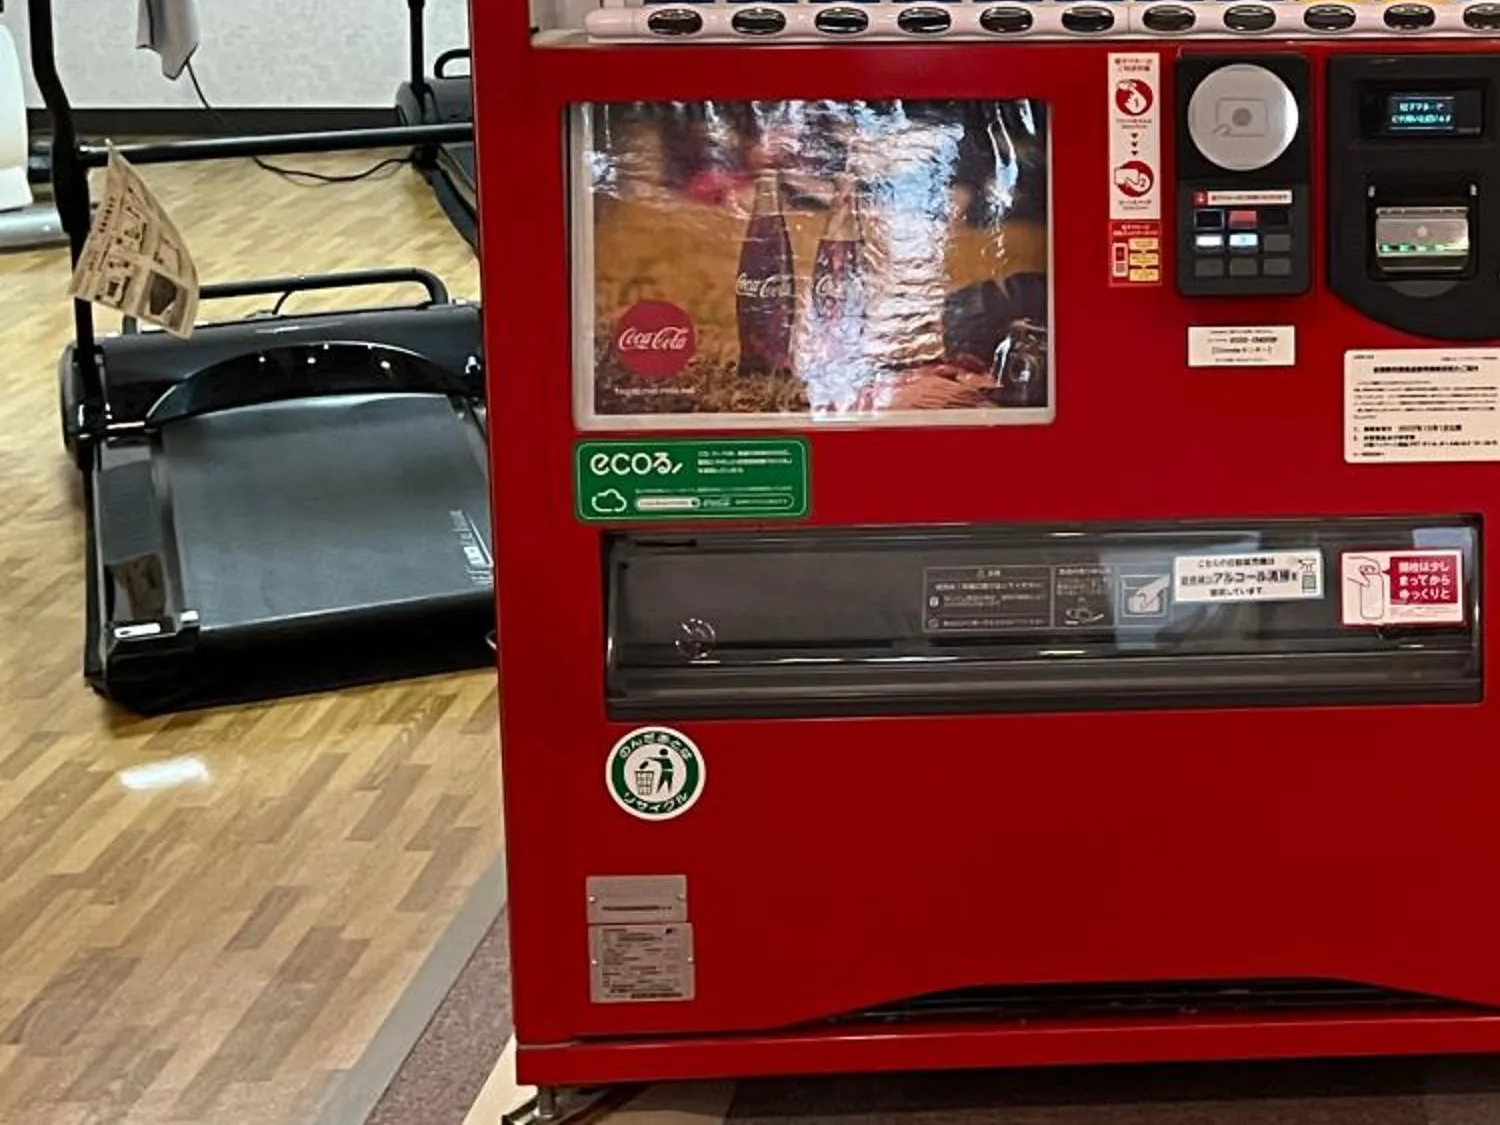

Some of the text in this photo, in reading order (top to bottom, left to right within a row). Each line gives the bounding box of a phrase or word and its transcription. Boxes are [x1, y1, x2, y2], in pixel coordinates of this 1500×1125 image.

[618, 325, 689, 351] Coca-Cola
[1398, 575, 1451, 586] まってから
[1398, 588, 1451, 603] ゆっくりと
[622, 791, 688, 813] リサイクル
